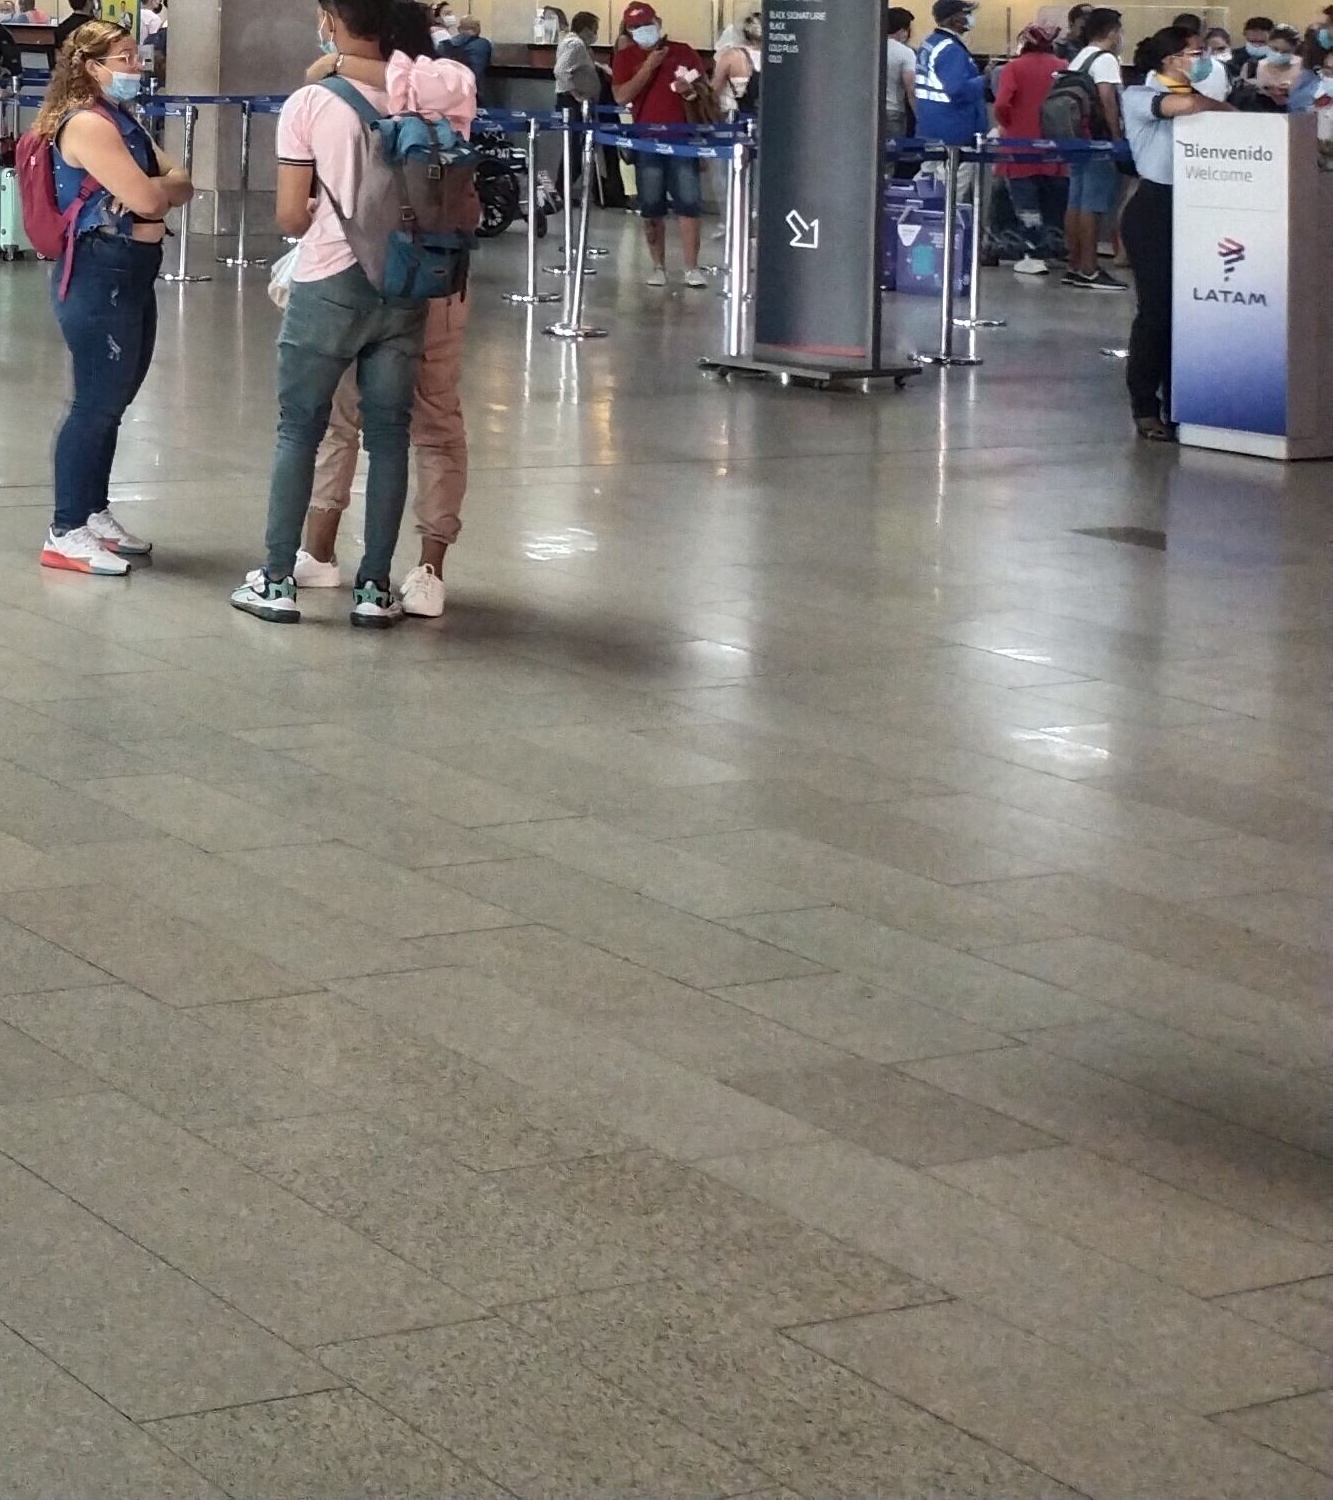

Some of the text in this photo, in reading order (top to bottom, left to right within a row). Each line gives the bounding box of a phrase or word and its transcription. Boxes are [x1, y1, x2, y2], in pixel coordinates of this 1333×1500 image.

[1183, 143, 1273, 162] Bienvenido
[1184, 164, 1254, 183] Welcome
[1192, 287, 1268, 307] LATAM
